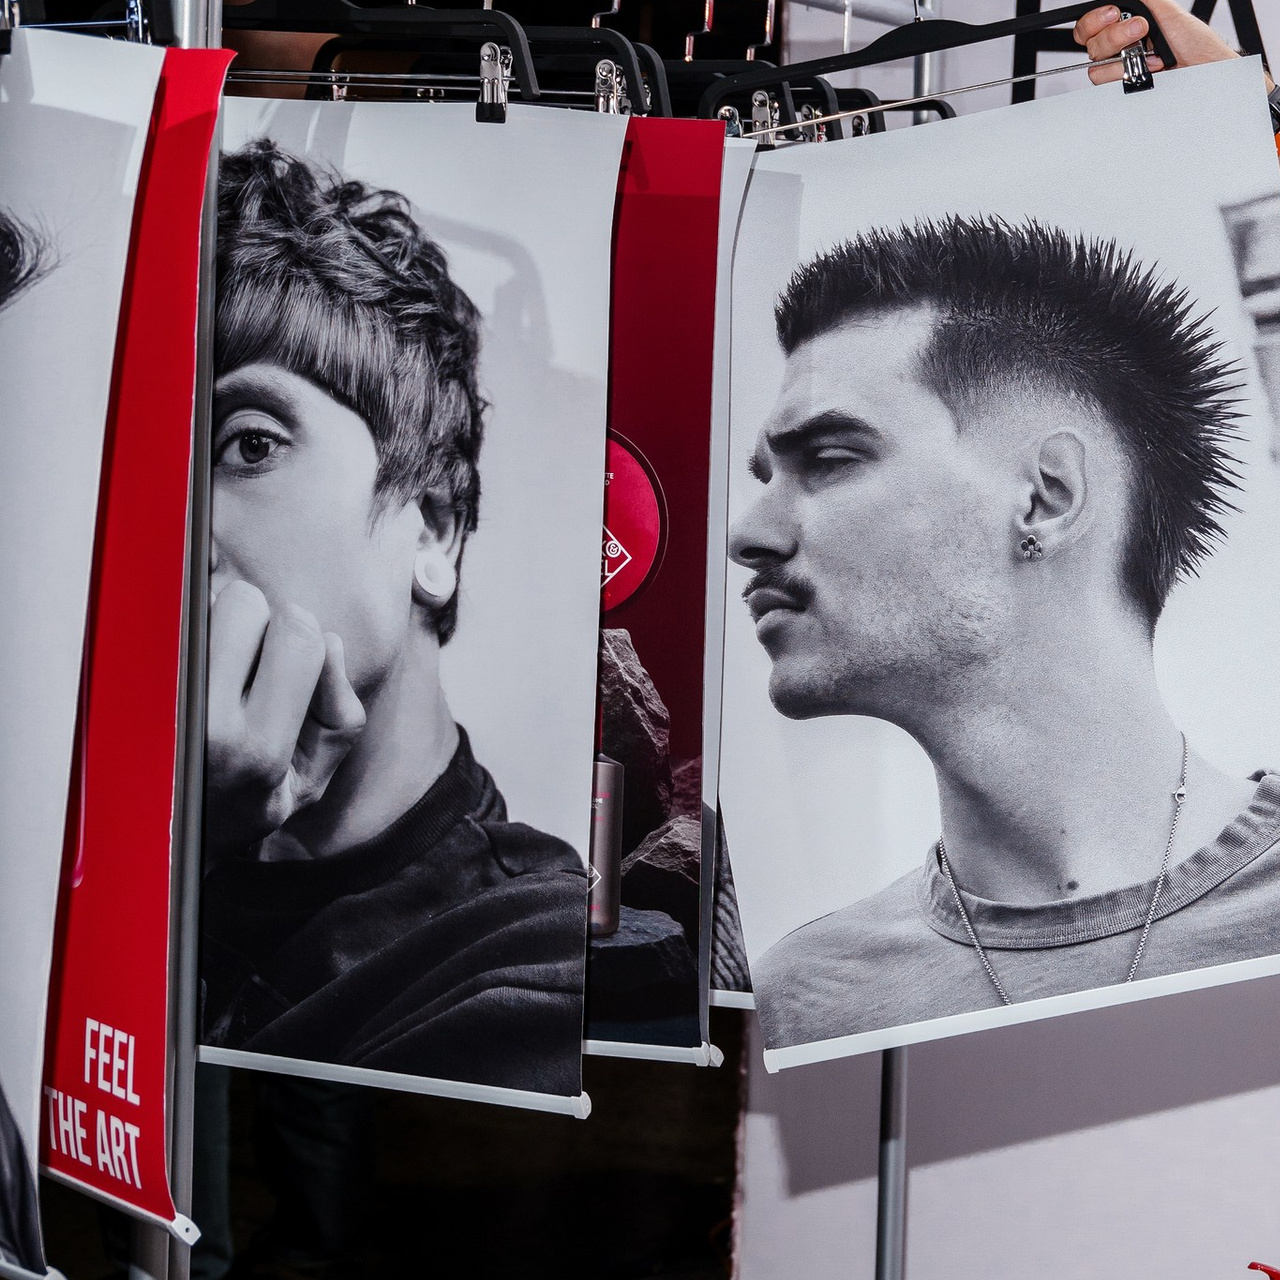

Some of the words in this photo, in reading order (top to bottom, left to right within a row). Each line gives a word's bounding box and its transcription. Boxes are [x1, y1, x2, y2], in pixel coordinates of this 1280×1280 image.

[84, 1017, 140, 1106] FEEL
[44, 1085, 92, 1167] THE
[96, 1109, 142, 1190] ART
